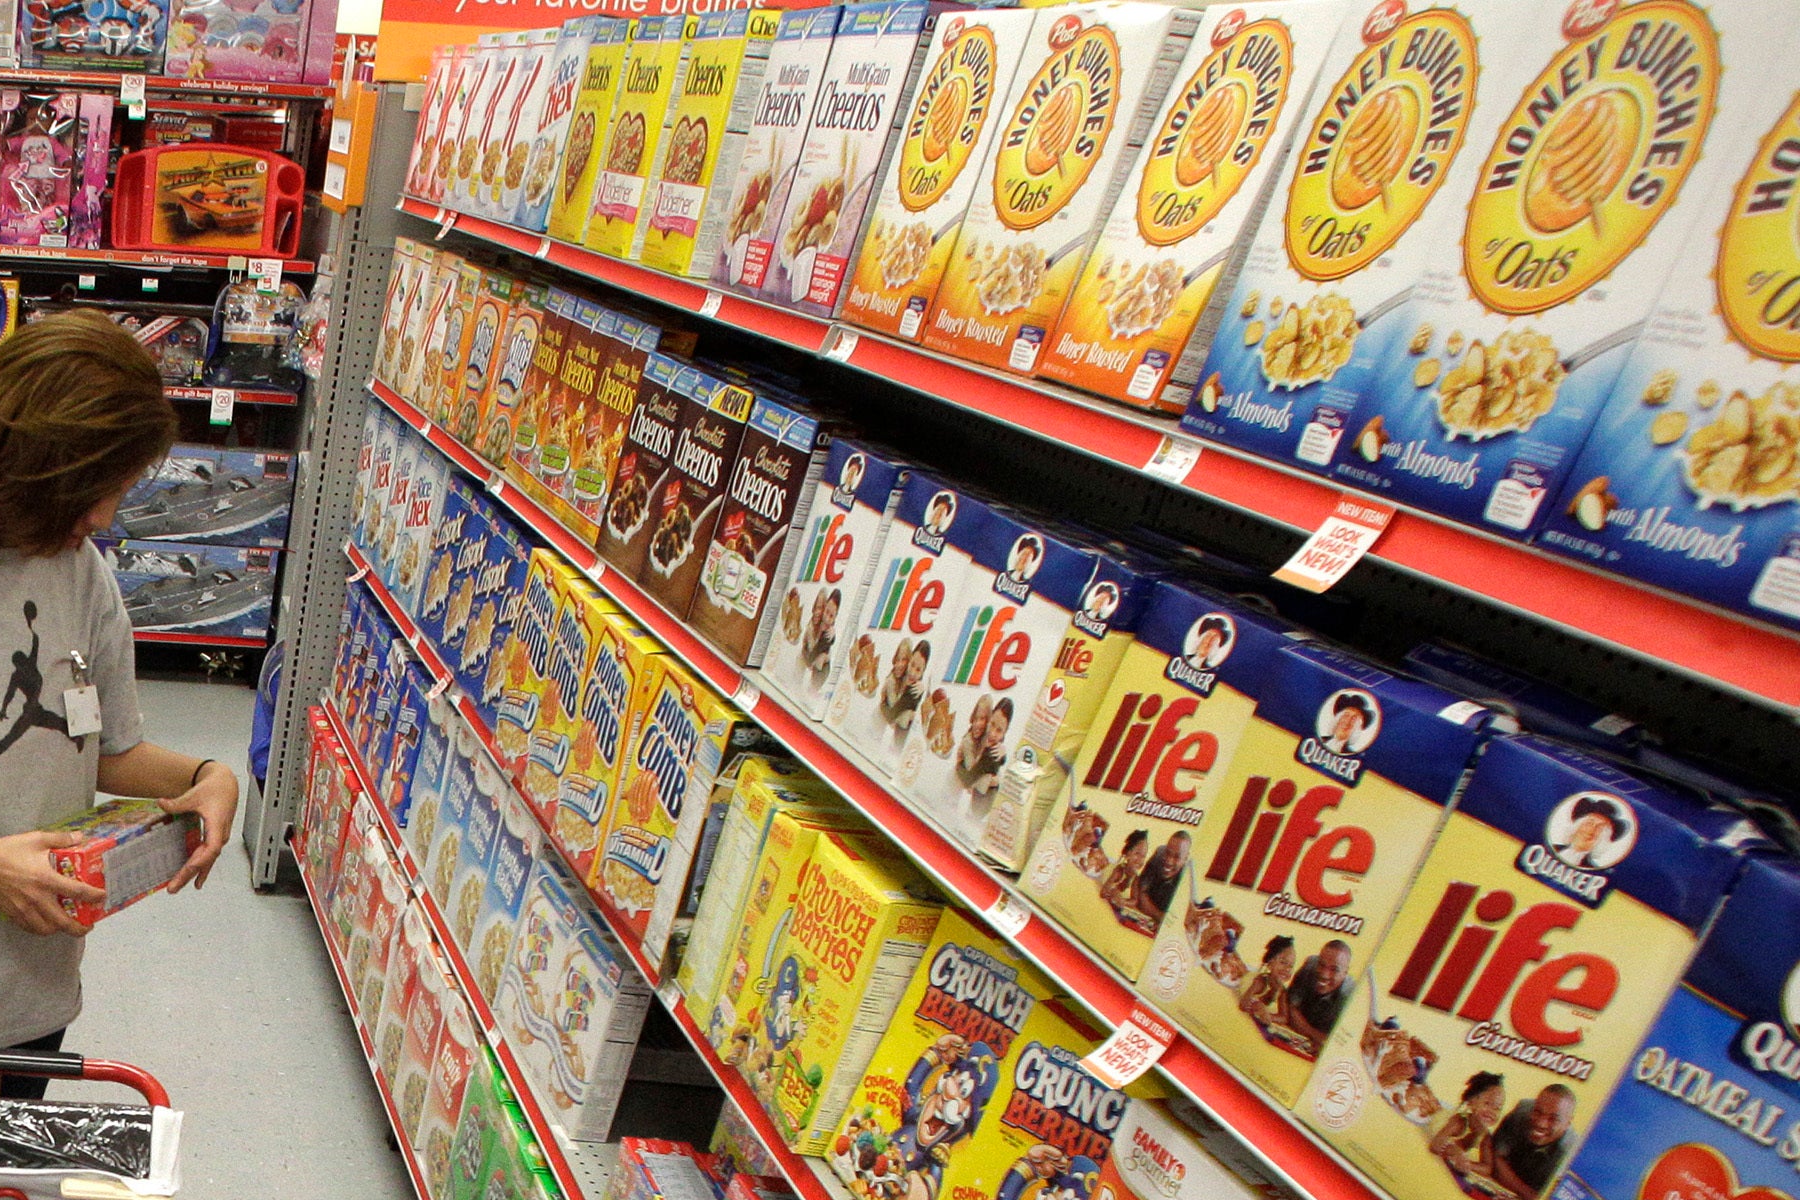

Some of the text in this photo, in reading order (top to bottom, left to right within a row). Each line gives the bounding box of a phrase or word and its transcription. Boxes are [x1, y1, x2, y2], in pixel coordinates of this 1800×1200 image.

[179, 80, 269, 94] celebrate holiday savings!
[626, 55, 662, 95] Cheerios
[684, 55, 727, 97] Cheerios
[753, 81, 806, 130] Cheerios
[815, 83, 882, 131] Cheerios
[1303, 25, 1463, 188] HONEY BUNCHES
[1487, 18, 1700, 207] HONEY BUNCHES
[910, 168, 941, 197] Oats
[1009, 177, 1052, 212] Oats
[1154, 189, 1204, 226] Oats
[141, 254, 208, 266] don't forget the tape
[1308, 217, 1373, 259] Oats
[1495, 247, 1580, 289] Oats
[597, 367, 636, 417] Cheerios
[1230, 392, 1295, 432] Almonds
[629, 401, 674, 461] Cheerios
[674, 424, 723, 488] Cheerios
[1400, 440, 1482, 488] Almonds
[730, 454, 788, 521] Cheerios
[1313, 533, 1359, 559] WHAT'S
[1328, 522, 1364, 545] LOOK
[1605, 506, 1636, 526] with
[1630, 508, 1748, 567] Almonds
[1298, 548, 1344, 577] NEW!
[869, 554, 947, 636] life
[942, 603, 1033, 693] life
[1053, 636, 1095, 678] life
[1168, 657, 1216, 693] QUAKER
[1083, 692, 1221, 804] life
[1299, 736, 1362, 782] QUAKER
[1125, 792, 1203, 826] Cinnamon
[1205, 773, 1378, 909] life
[1523, 844, 1608, 900] QUAKER
[798, 860, 878, 943] CRUNCH
[1264, 892, 1364, 936] Cinnamon
[931, 942, 1032, 1032] CRUNCH
[1389, 881, 1621, 1048] life
[1102, 1050, 1140, 1076] NEW!
[1465, 1020, 1595, 1082] Cinnamon
[1632, 1046, 1778, 1146] OATMEAL
